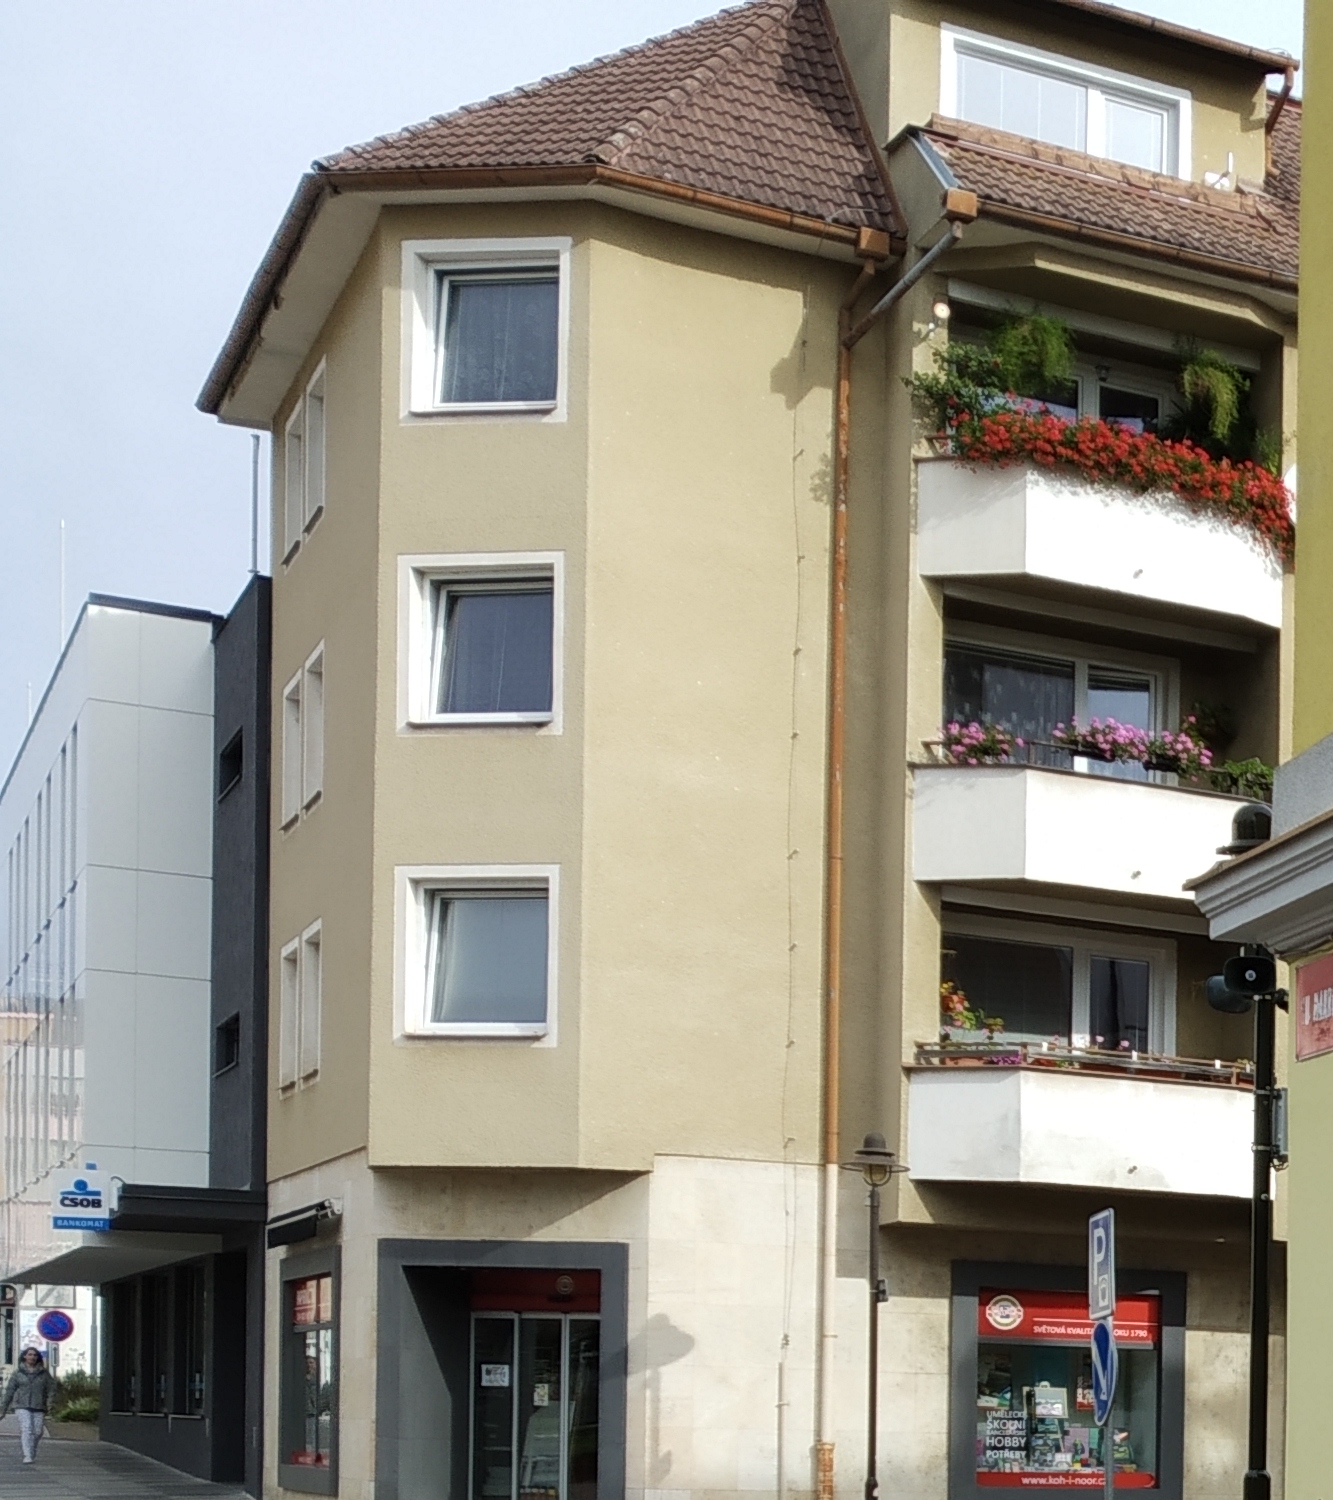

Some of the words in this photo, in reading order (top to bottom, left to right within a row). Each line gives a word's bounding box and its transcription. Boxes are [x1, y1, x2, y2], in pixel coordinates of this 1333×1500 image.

[59, 1194, 103, 1209] ČSOB
[1093, 1226, 1107, 1286] P
[985, 1436, 1027, 1448] HOBBY
[985, 1449, 1027, 1459] POTŘEBY
